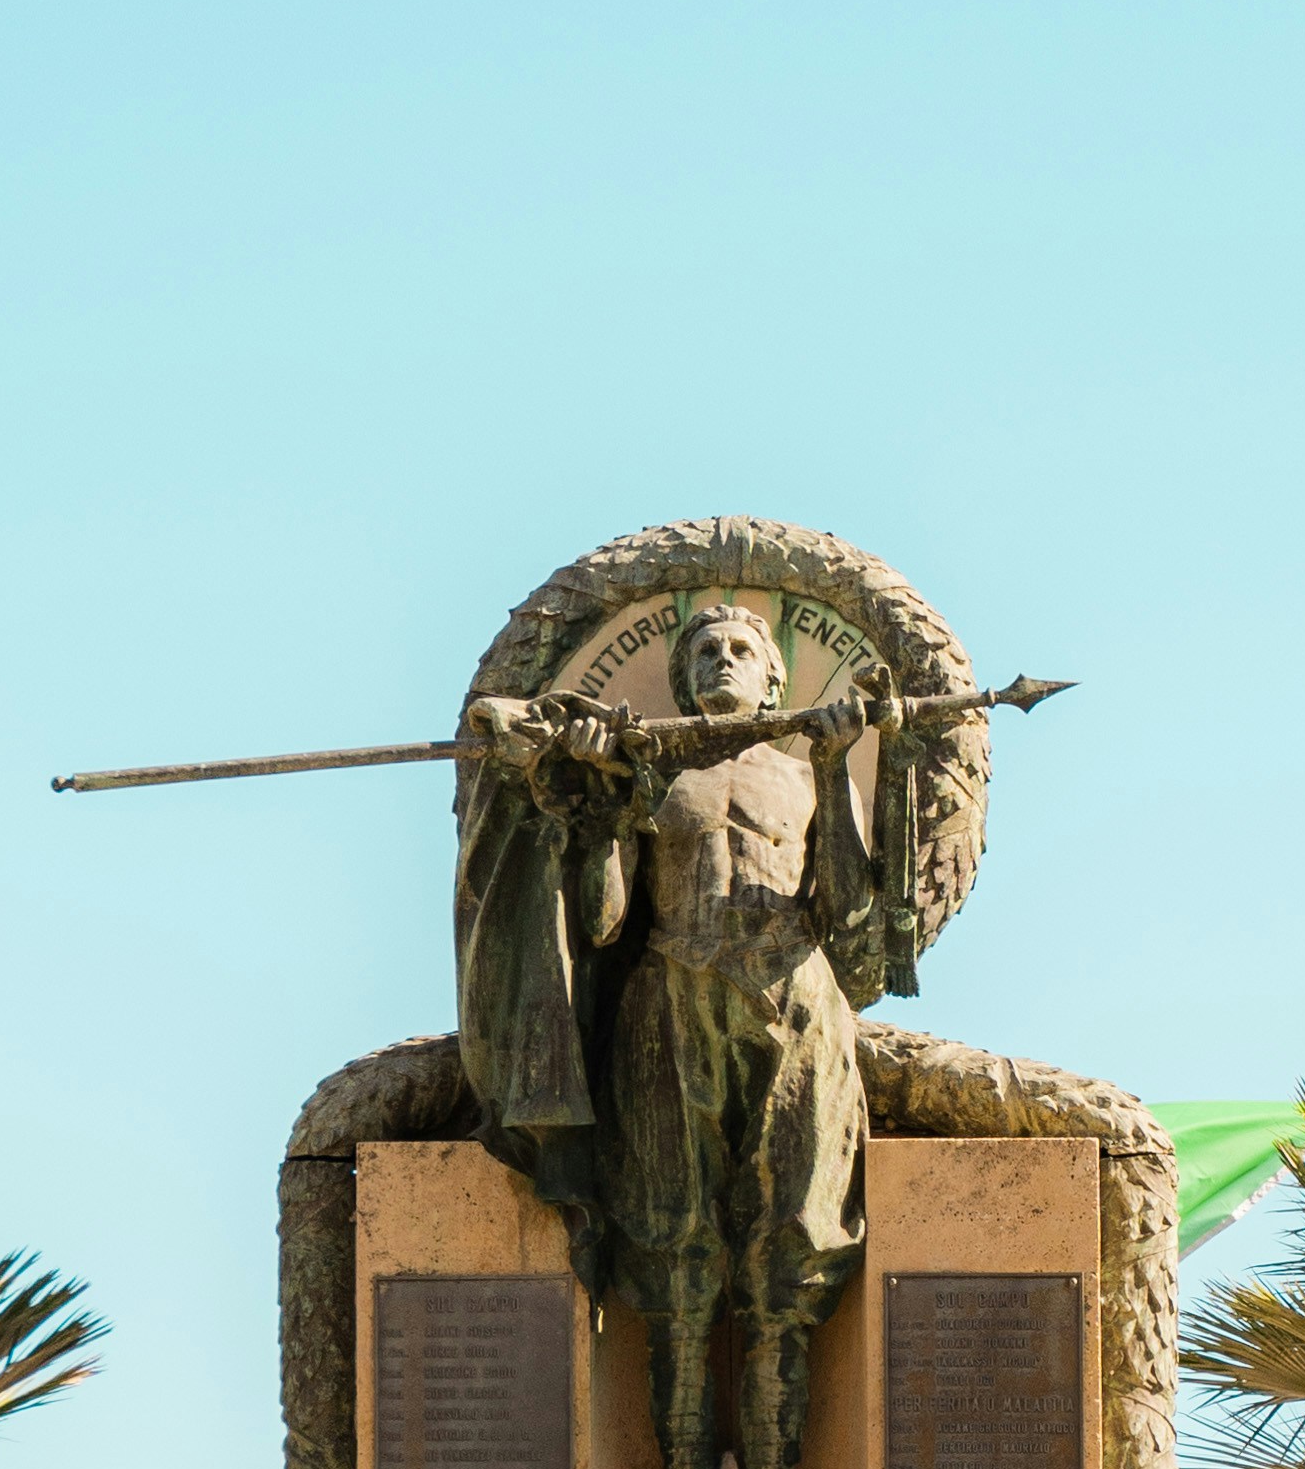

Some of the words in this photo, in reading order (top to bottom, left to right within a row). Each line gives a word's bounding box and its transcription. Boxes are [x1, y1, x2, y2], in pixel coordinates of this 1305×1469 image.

[574, 604, 682, 699] VITTORIO
[781, 595, 875, 668] VENET
[935, 1291, 965, 1309] SUL
[976, 1291, 1031, 1309] CAMPO
